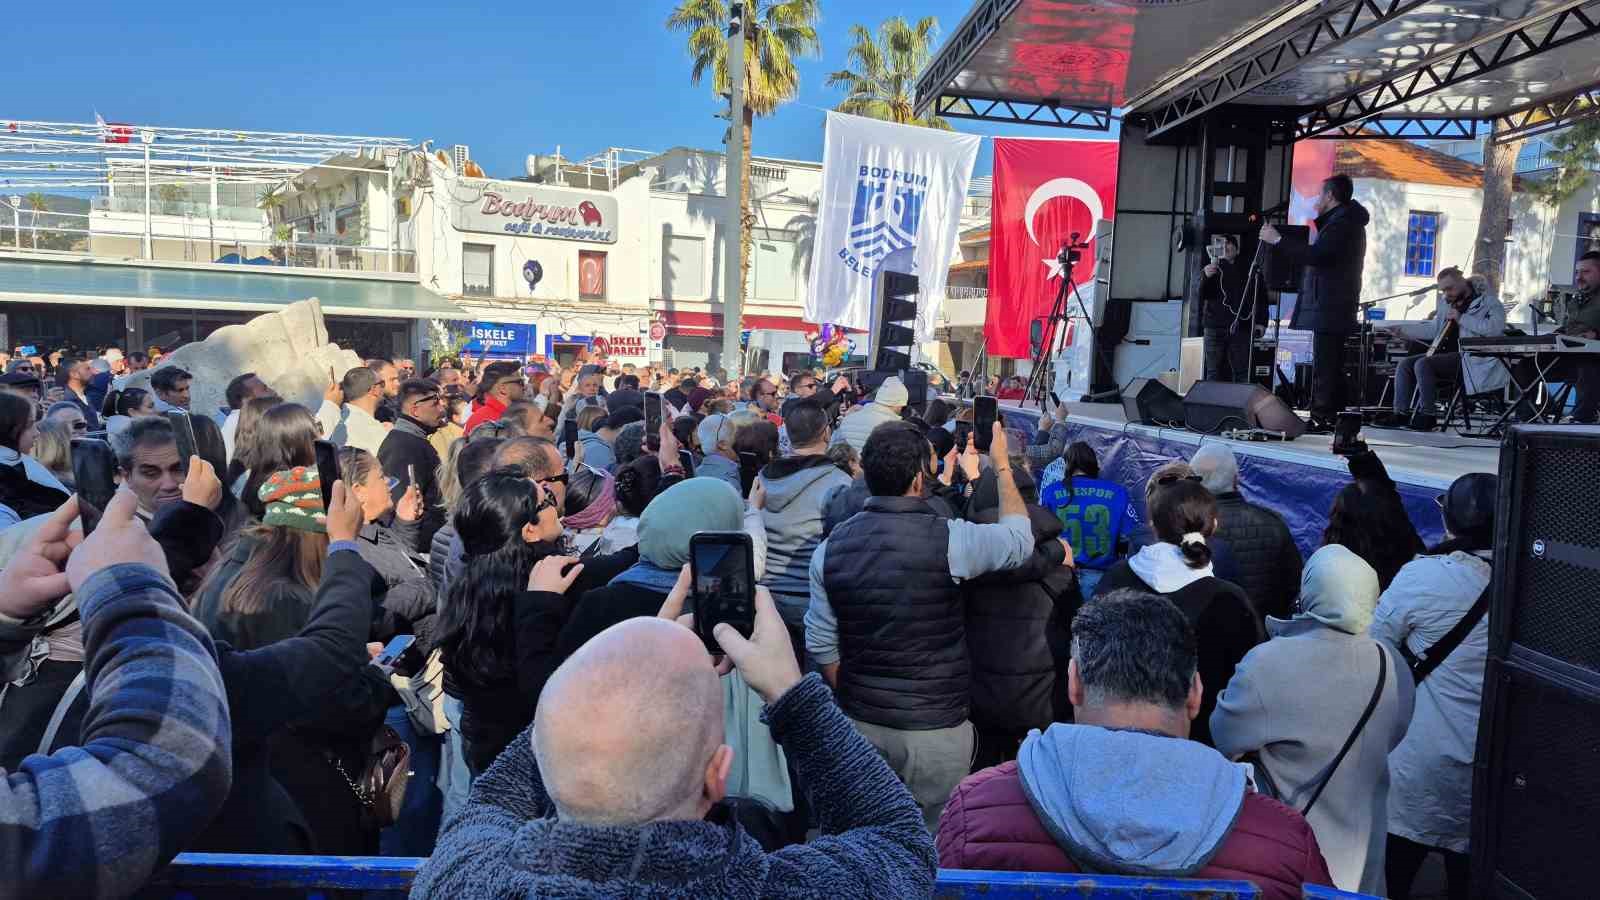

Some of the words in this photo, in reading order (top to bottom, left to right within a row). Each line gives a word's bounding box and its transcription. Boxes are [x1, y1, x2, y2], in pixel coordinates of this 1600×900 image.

[859, 165, 928, 187] BODRUM
[481, 191, 577, 226] Bodrum
[472, 326, 515, 341] İSKELE
[1056, 504, 1110, 558] 53
